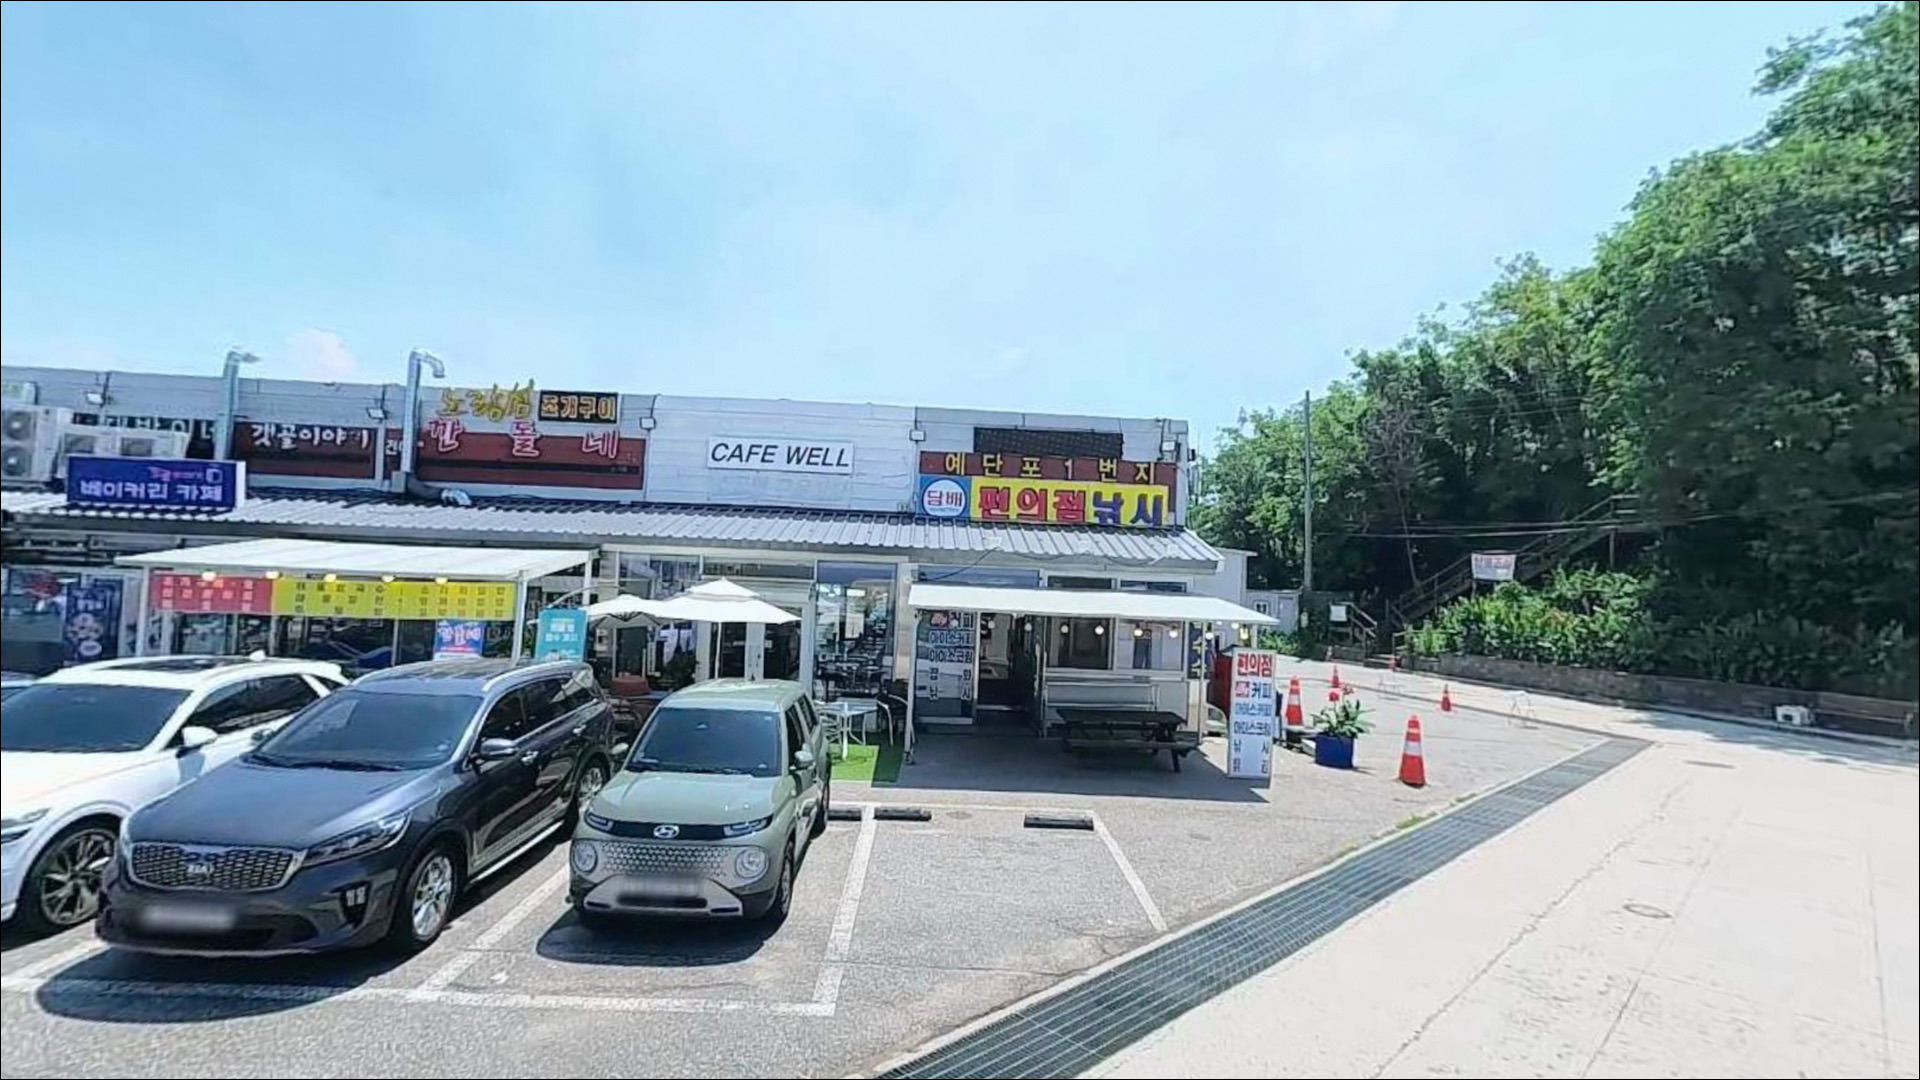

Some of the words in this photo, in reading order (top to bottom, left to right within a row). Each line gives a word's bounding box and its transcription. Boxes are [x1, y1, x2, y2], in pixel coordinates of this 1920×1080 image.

[541, 394, 616, 420] 조개구이
[711, 442, 779, 464] CAFE
[786, 445, 850, 468] WELL
[80, 480, 168, 501] 베이커리
[176, 484, 223, 502] 카페
[927, 490, 963, 507] 담배
[979, 486, 1086, 522] 편의점
[1092, 491, 1163, 527] 낚시
[1237, 653, 1273, 677] 편의점
[1251, 682, 1272, 698] 커피
